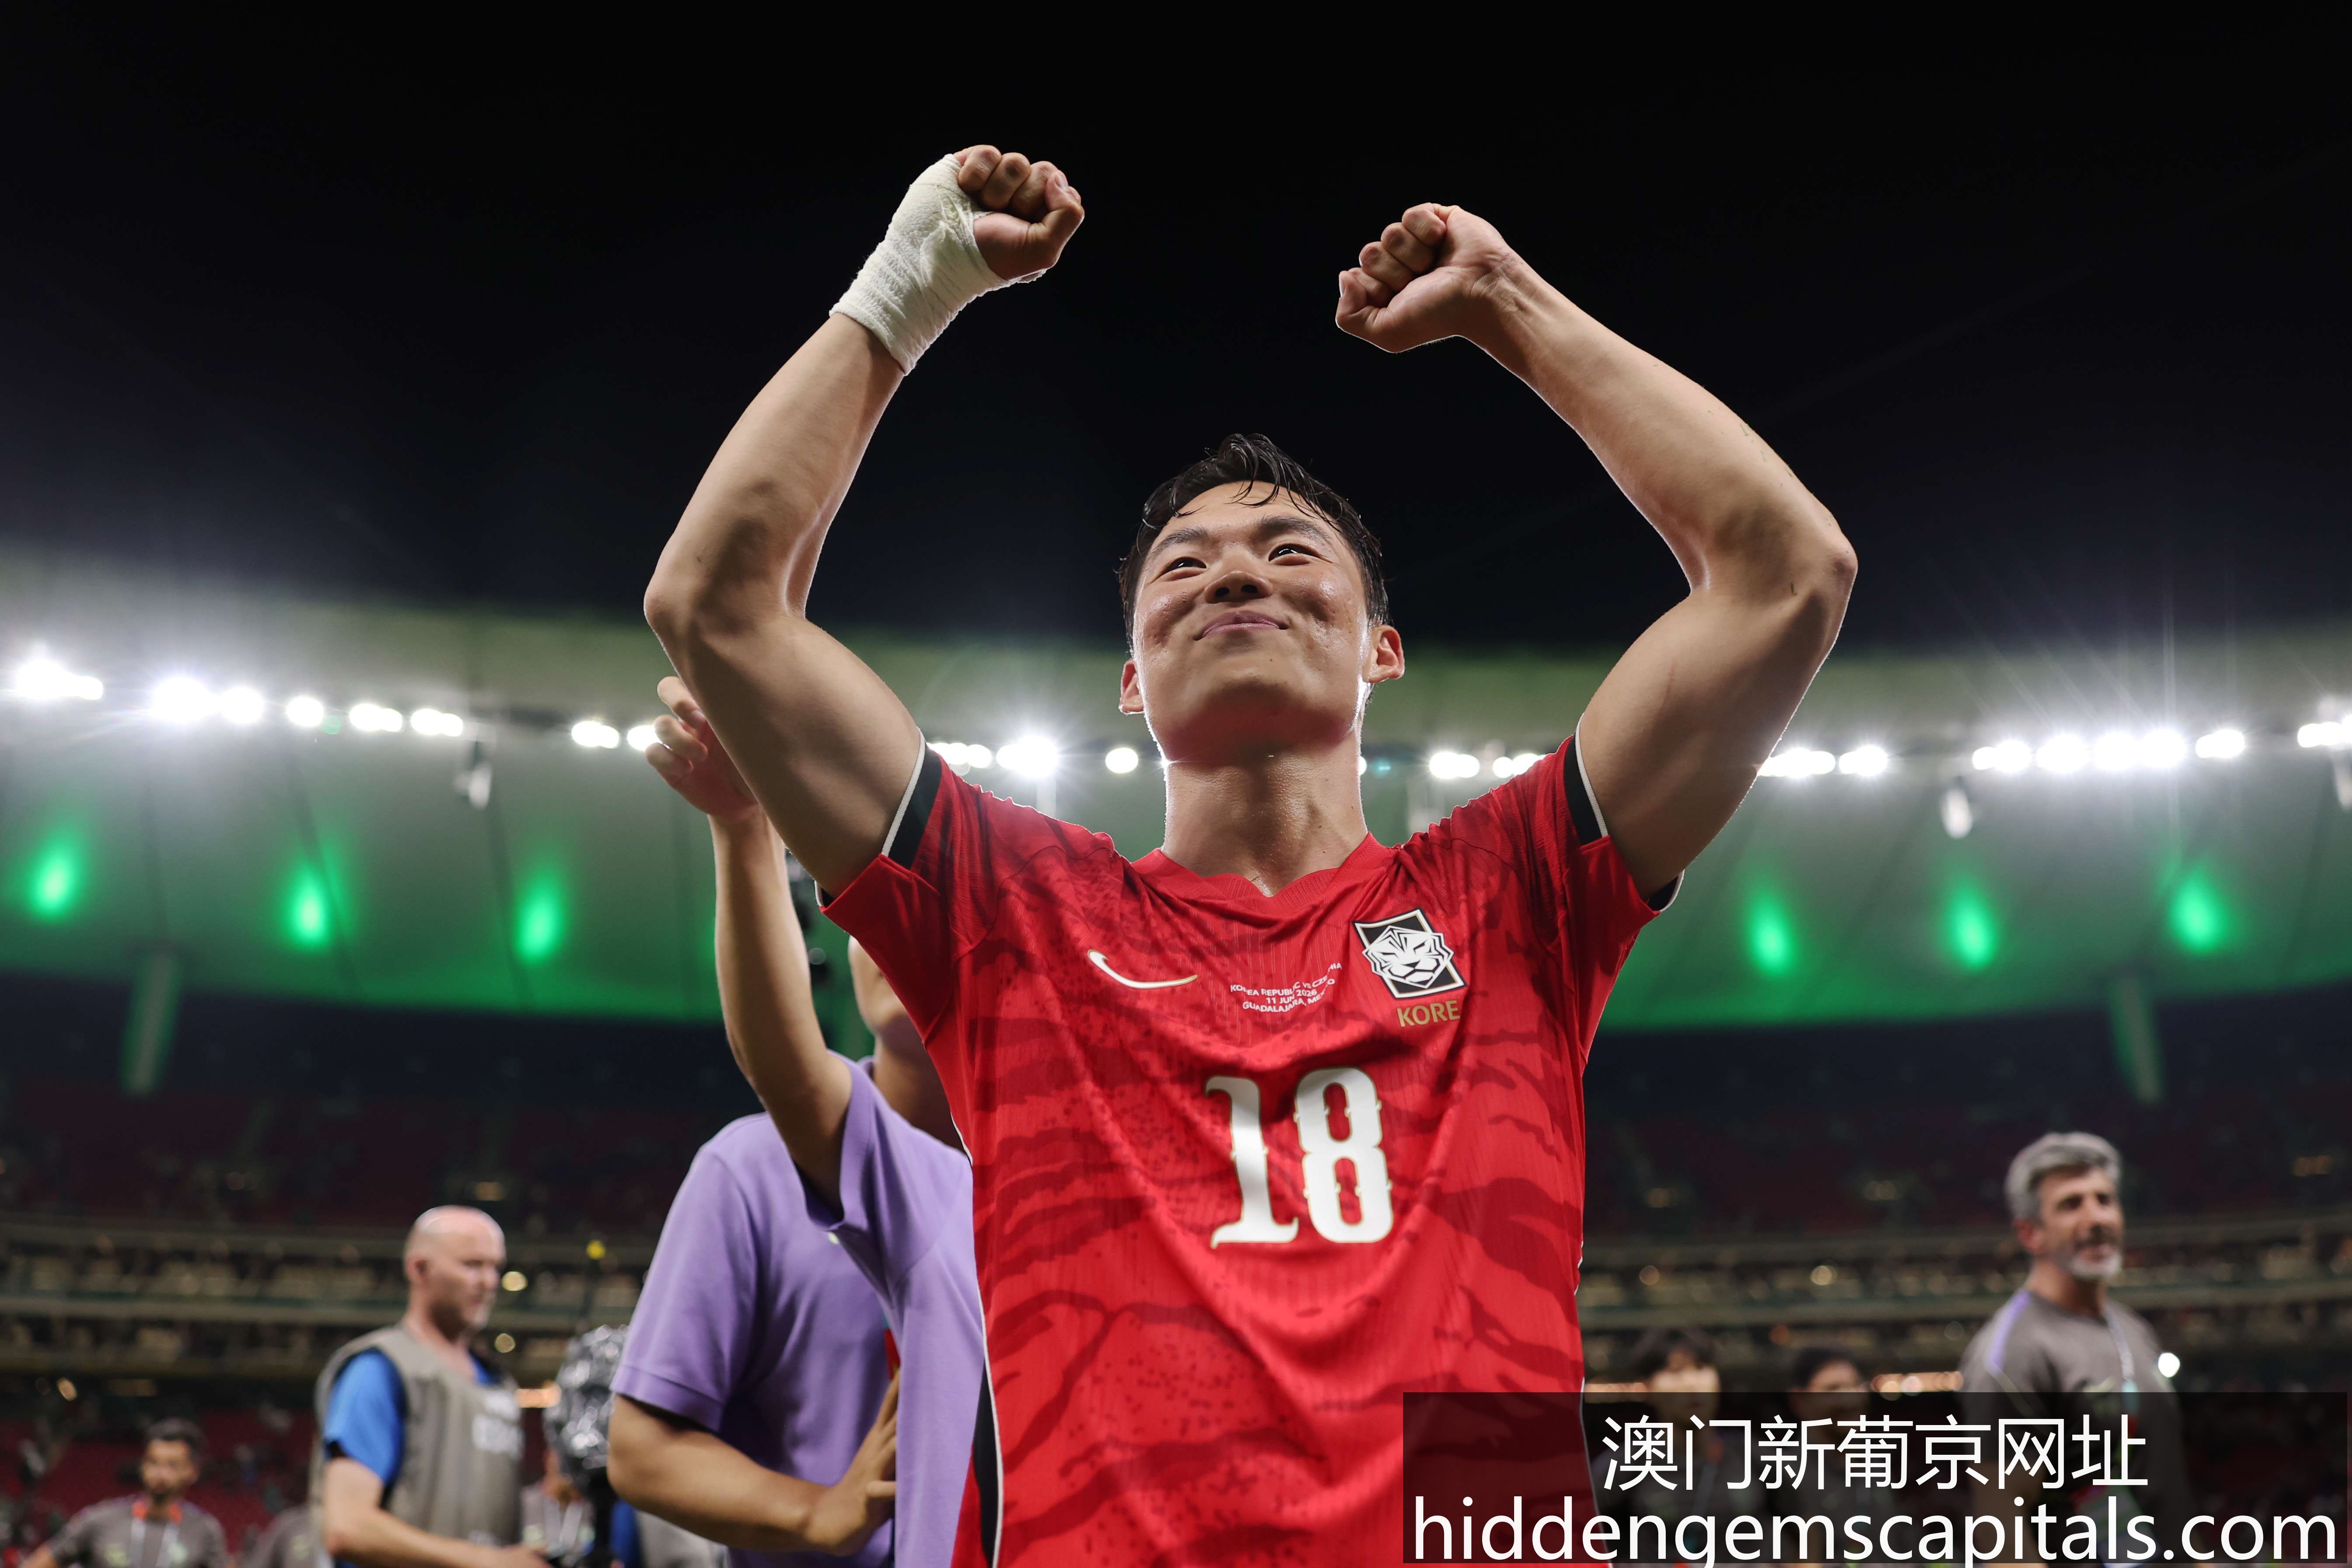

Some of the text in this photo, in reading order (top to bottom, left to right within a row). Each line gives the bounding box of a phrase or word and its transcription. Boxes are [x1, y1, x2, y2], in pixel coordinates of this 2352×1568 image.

[1230, 984, 1260, 996] KOREA
[1261, 981, 1301, 996] REPUBLIC
[1279, 994, 1295, 1004] JUN
[1296, 989, 1317, 997] 2026
[1242, 998, 1307, 1012] GUADALAJARA,
[1205, 1065, 1394, 1249] 18
